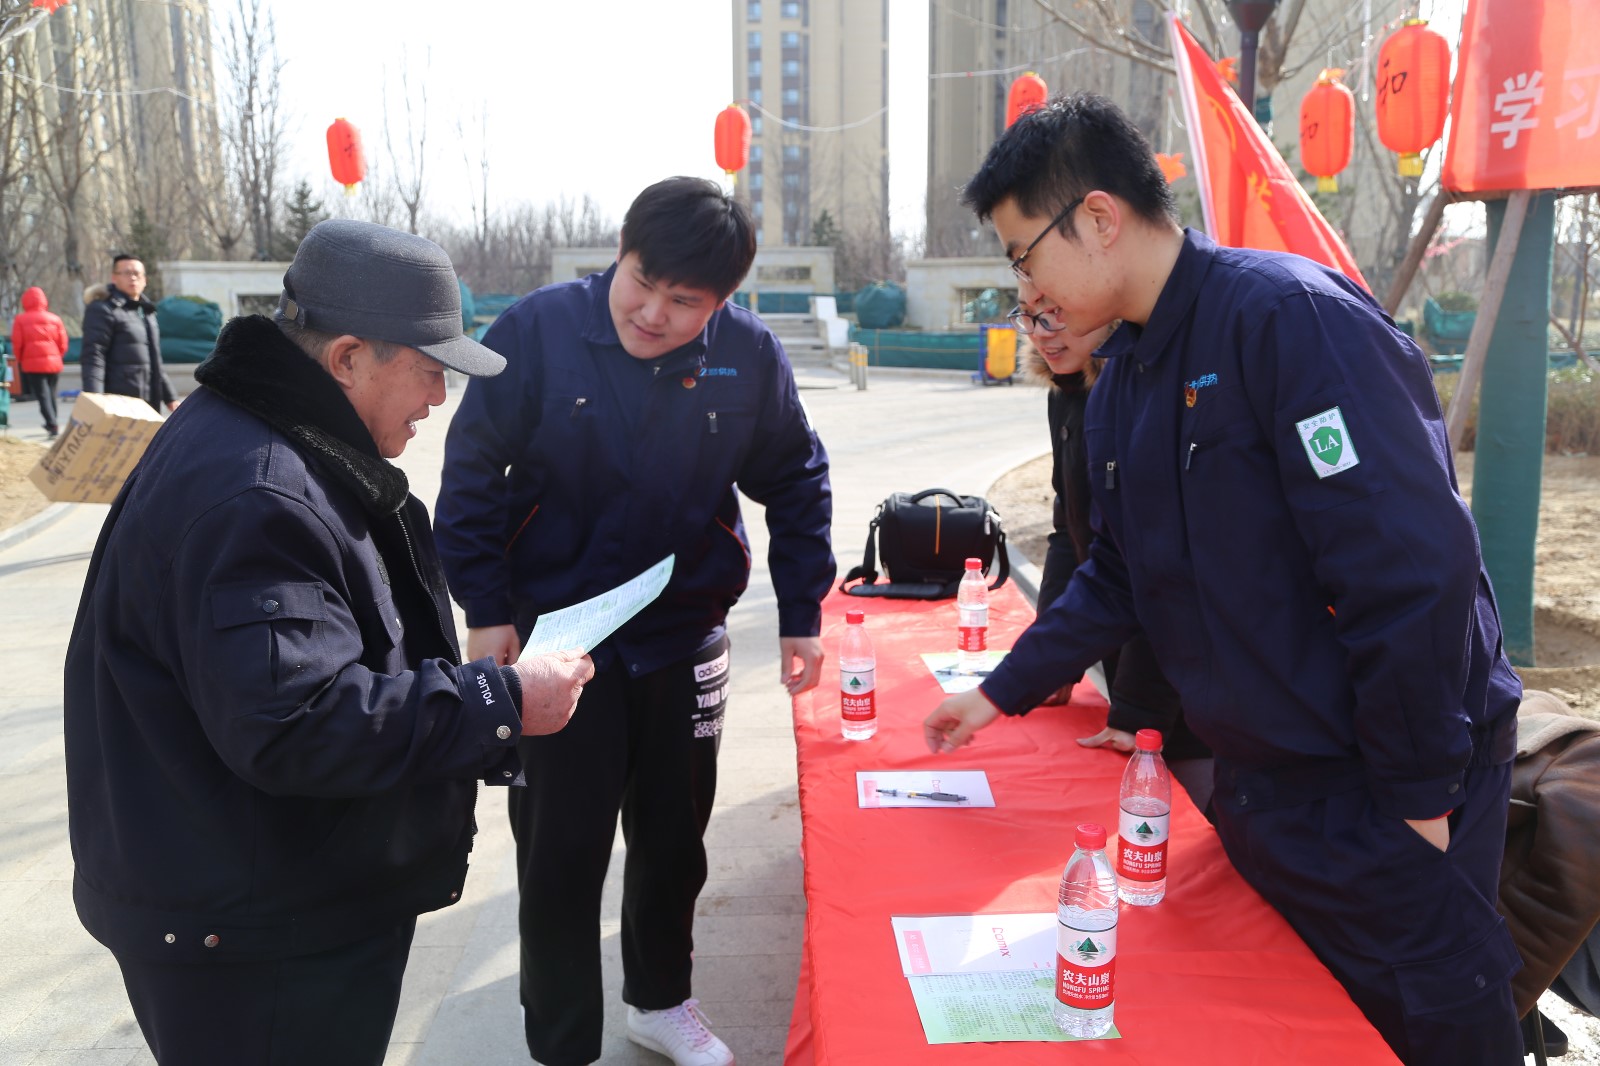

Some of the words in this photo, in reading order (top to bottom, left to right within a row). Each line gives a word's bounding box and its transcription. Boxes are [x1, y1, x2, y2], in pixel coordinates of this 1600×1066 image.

[1491, 65, 1600, 149] 学习
[1313, 434, 1340, 454] LA
[476, 672, 496, 706] POLICE
[1123, 847, 1163, 863] 农夫山泉
[1062, 968, 1111, 987] 农夫山泉
[1062, 981, 1087, 994] NONGFU
[1088, 984, 1110, 994] SPRING
